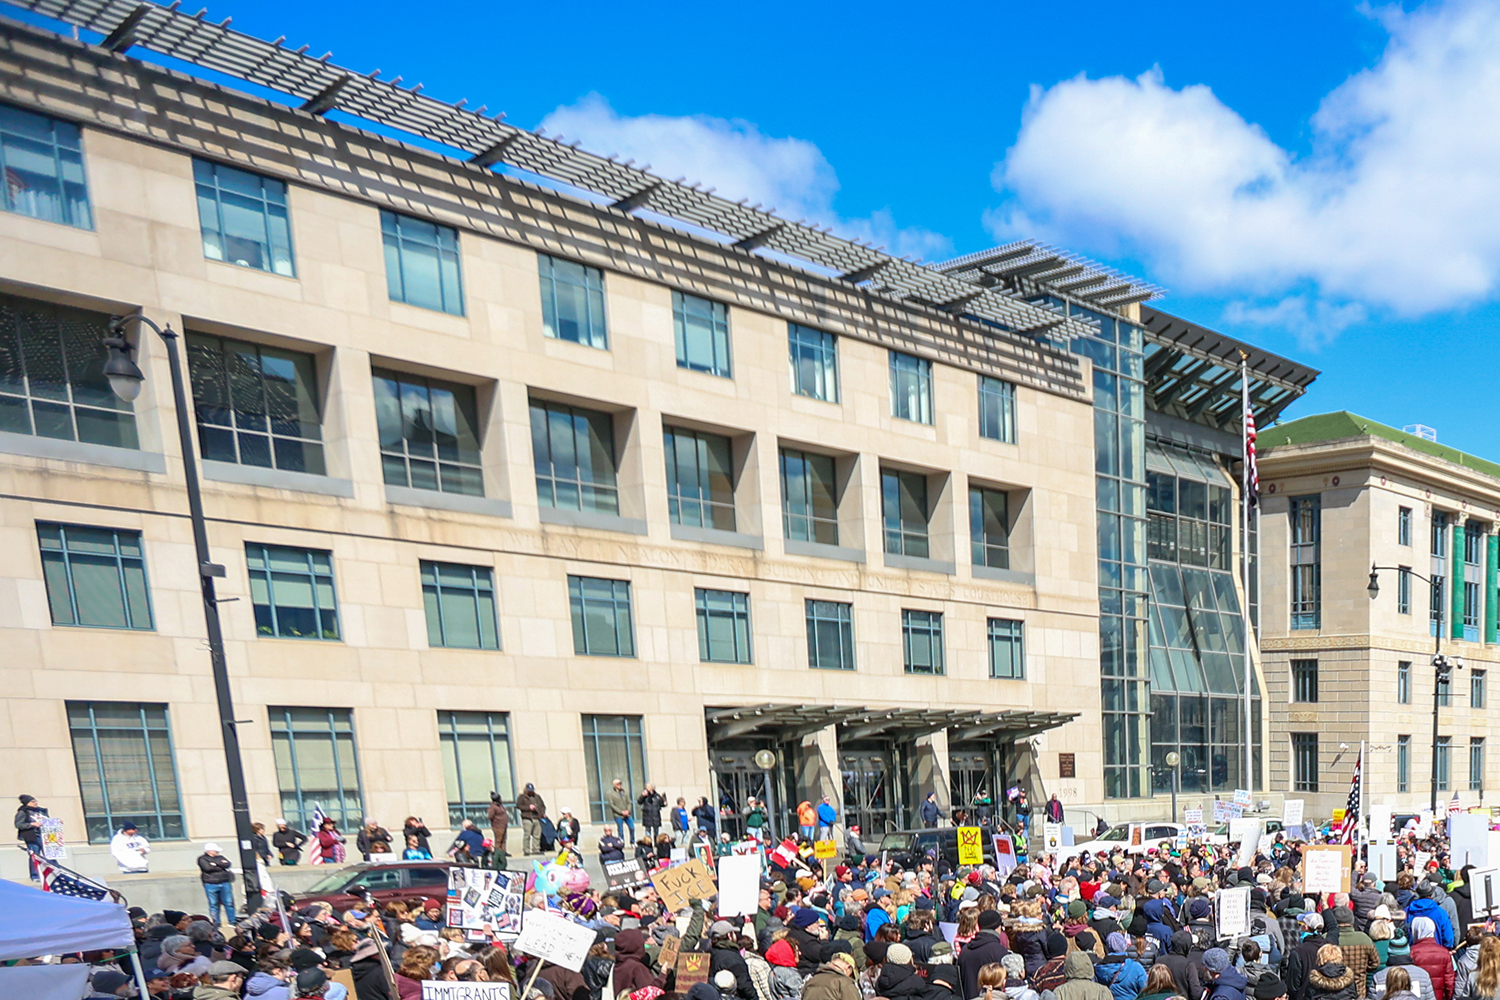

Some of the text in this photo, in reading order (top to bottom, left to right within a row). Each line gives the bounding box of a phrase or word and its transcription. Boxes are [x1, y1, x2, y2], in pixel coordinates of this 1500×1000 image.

[765, 562, 824, 582] BUILDING
[833, 571, 860, 585] AND
[866, 572, 910, 592] UNITED
[918, 582, 956, 598] STATES
[963, 586, 1029, 606] COURTHOUSE
[1059, 787, 1078, 797] 1998
[660, 866, 701, 892] FUCK
[668, 880, 712, 905] ICE
[524, 936, 555, 953] LEAD
